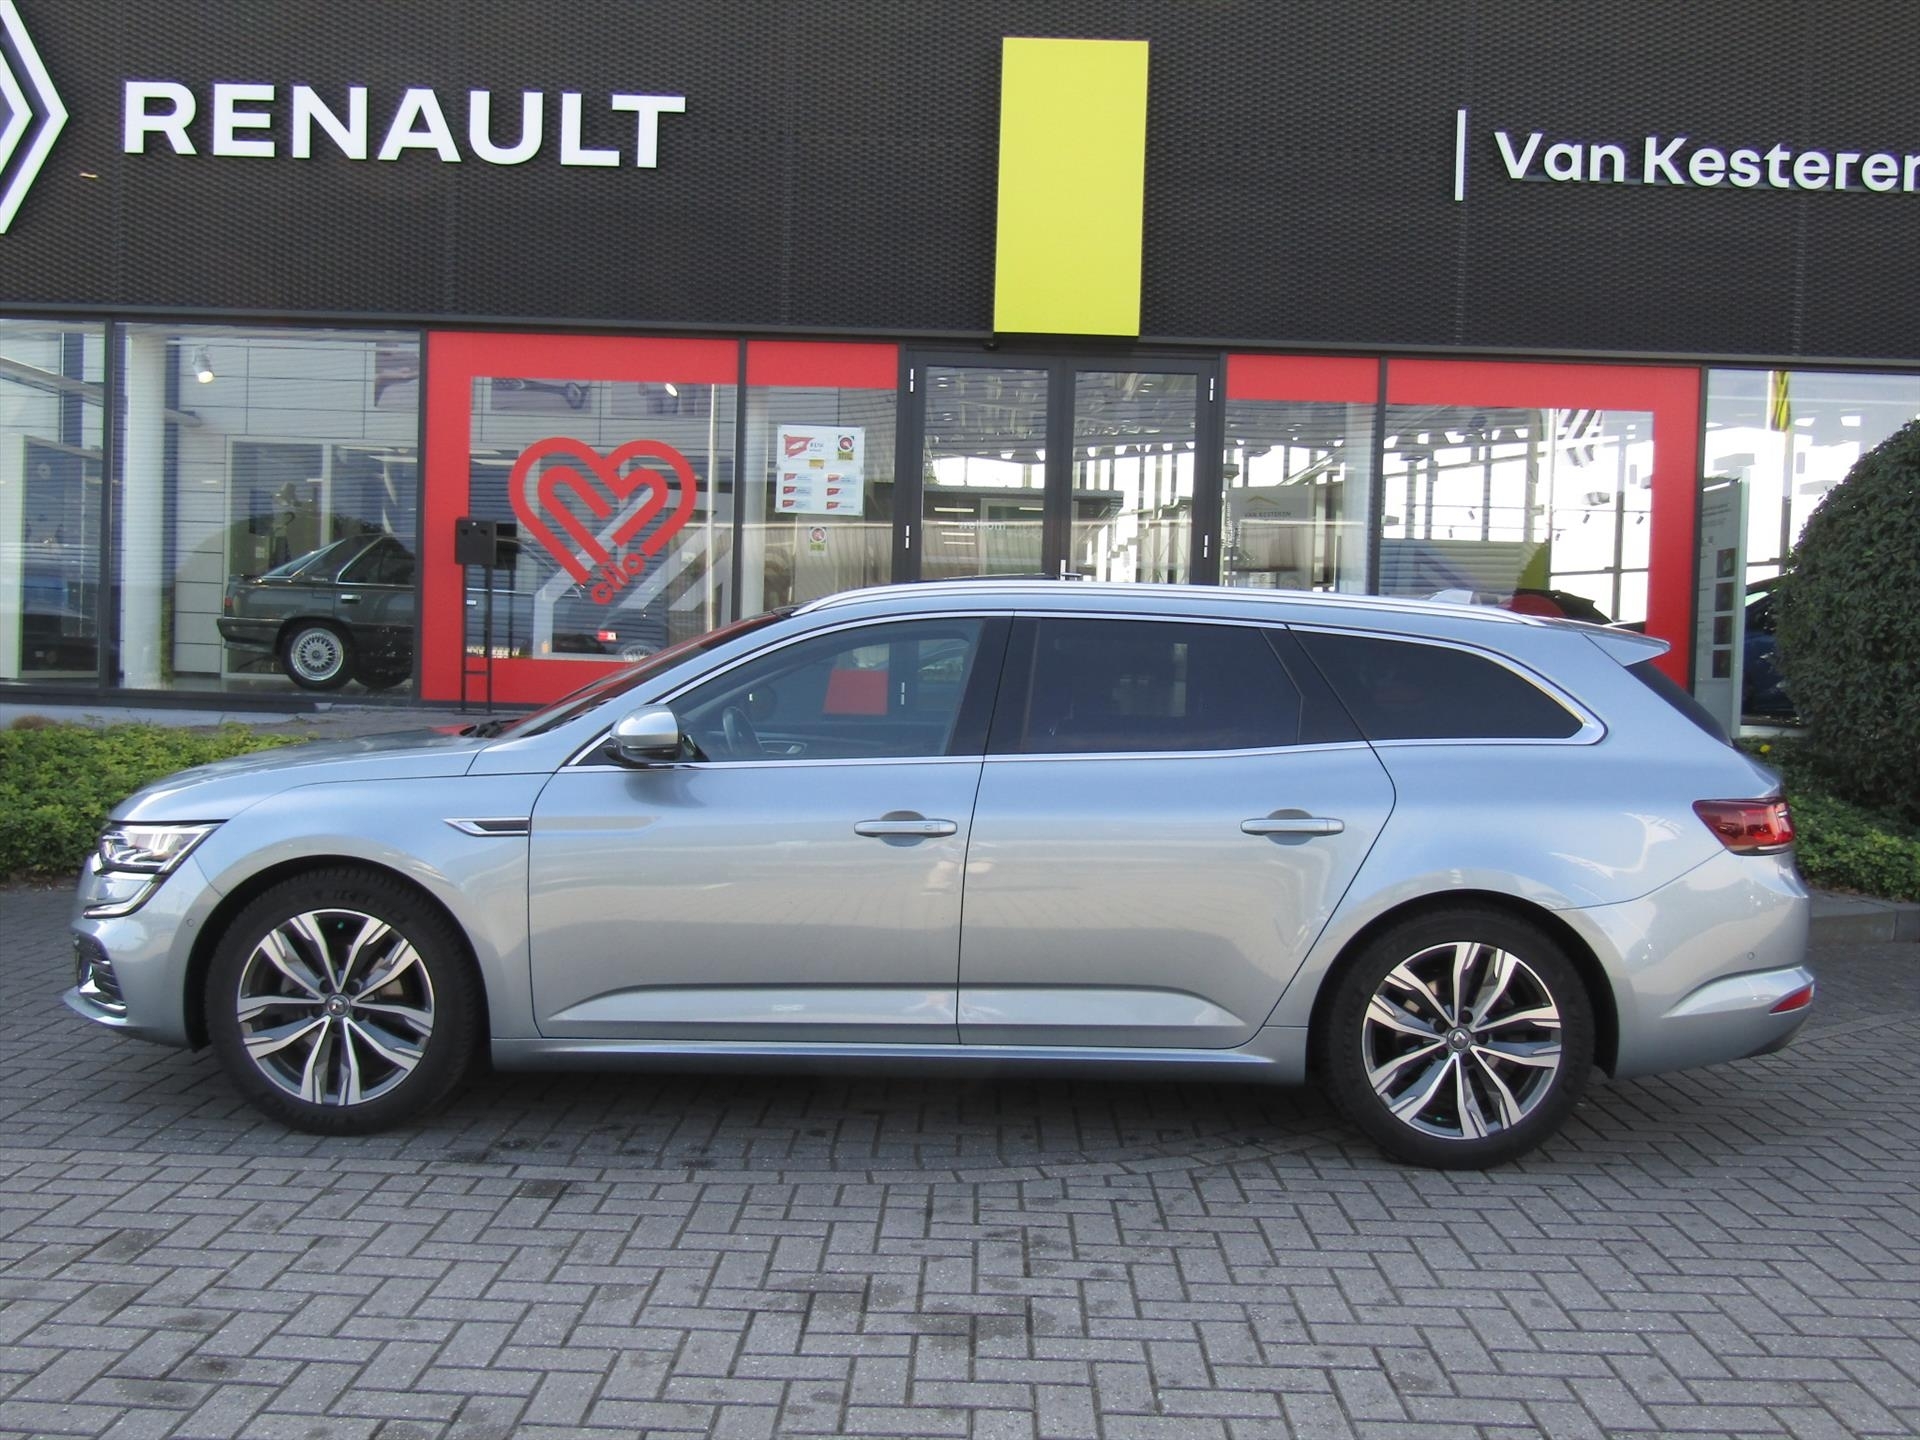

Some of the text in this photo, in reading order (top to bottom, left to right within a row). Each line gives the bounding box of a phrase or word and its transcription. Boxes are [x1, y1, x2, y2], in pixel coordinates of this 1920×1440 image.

[123, 80, 686, 169] RENAULT
[1494, 131, 1626, 183] Van
[592, 553, 644, 604] clio
